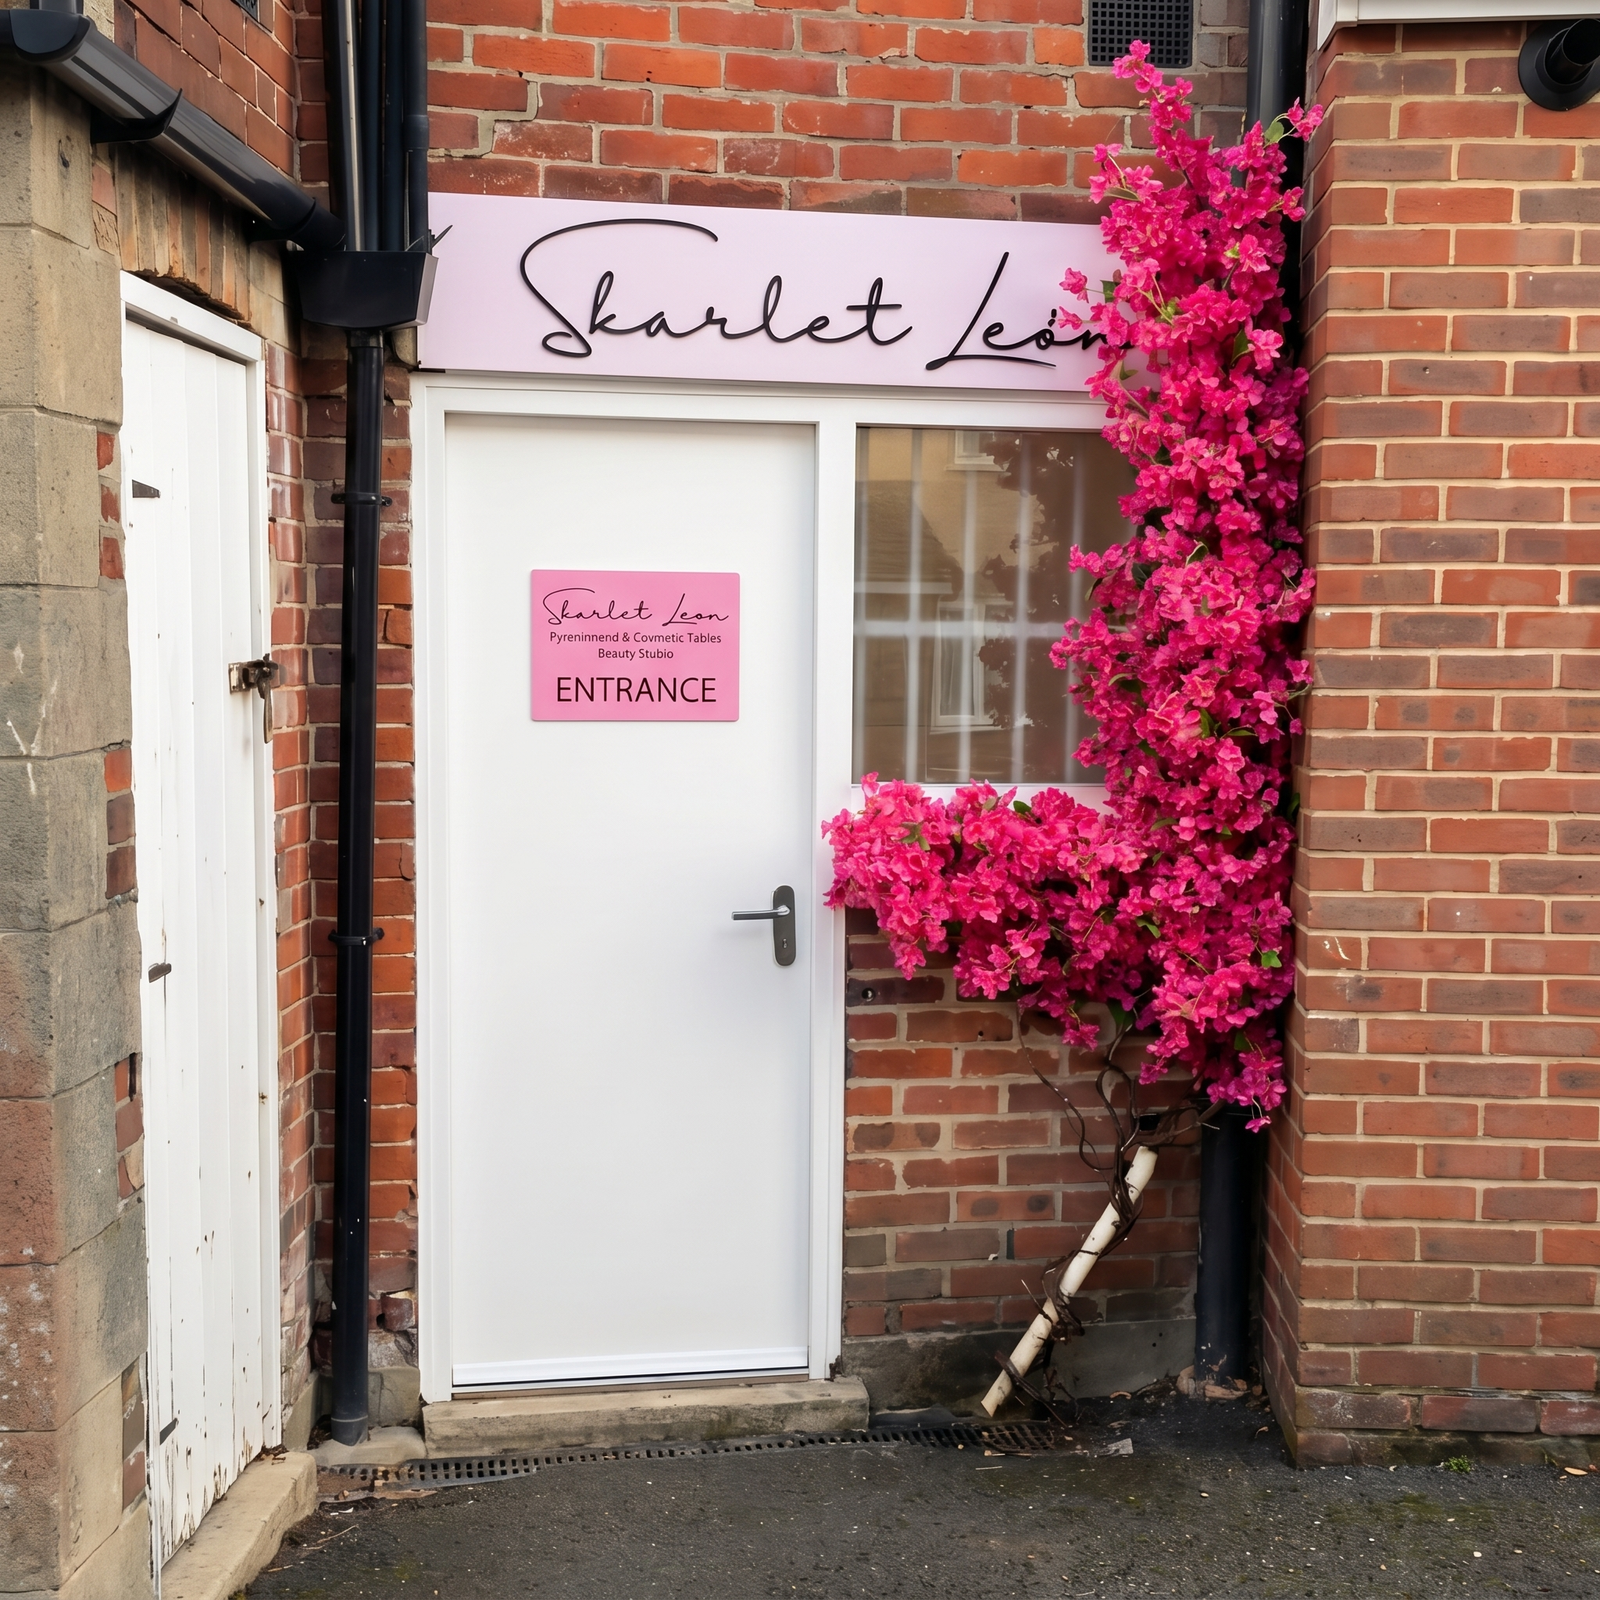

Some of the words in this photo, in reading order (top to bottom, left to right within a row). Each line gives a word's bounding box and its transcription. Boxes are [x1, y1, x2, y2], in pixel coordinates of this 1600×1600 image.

[519, 217, 913, 358] Skarlet
[542, 587, 653, 626] Skarlet
[661, 593, 729, 627] Leon
[621, 631, 631, 643] &
[687, 633, 722, 644] Tables
[598, 648, 636, 662] Beauty
[638, 648, 674, 660] Stubio
[557, 676, 717, 703] ENTRANCE
